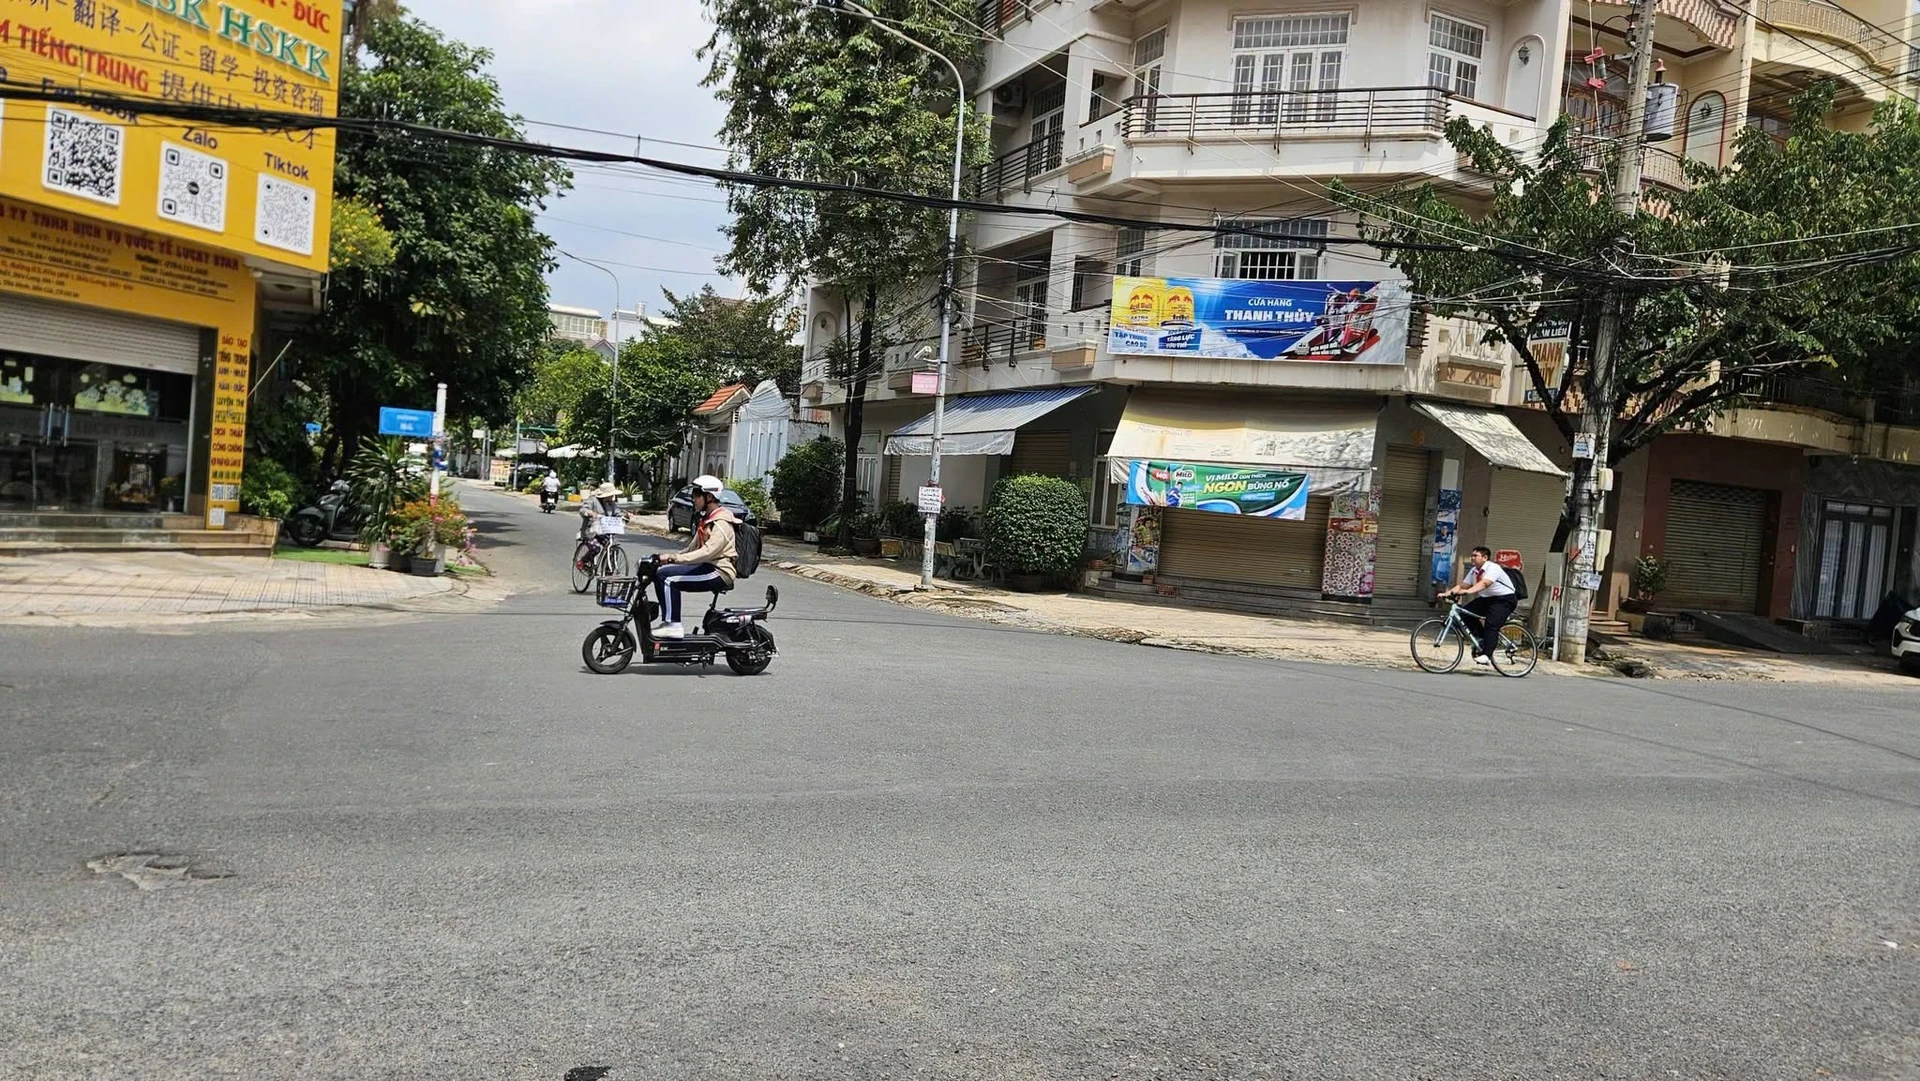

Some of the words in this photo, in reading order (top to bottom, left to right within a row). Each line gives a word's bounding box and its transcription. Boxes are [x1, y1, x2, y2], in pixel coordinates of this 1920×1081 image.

[217, 2, 331, 82] HSKK
[17, 24, 78, 67] TIẾNG
[85, 49, 149, 92] TRUNG
[183, 126, 218, 149] Zalo
[264, 152, 309, 180] Tiktok
[1225, 310, 1272, 321] THANH
[1203, 480, 1247, 494] NGON
